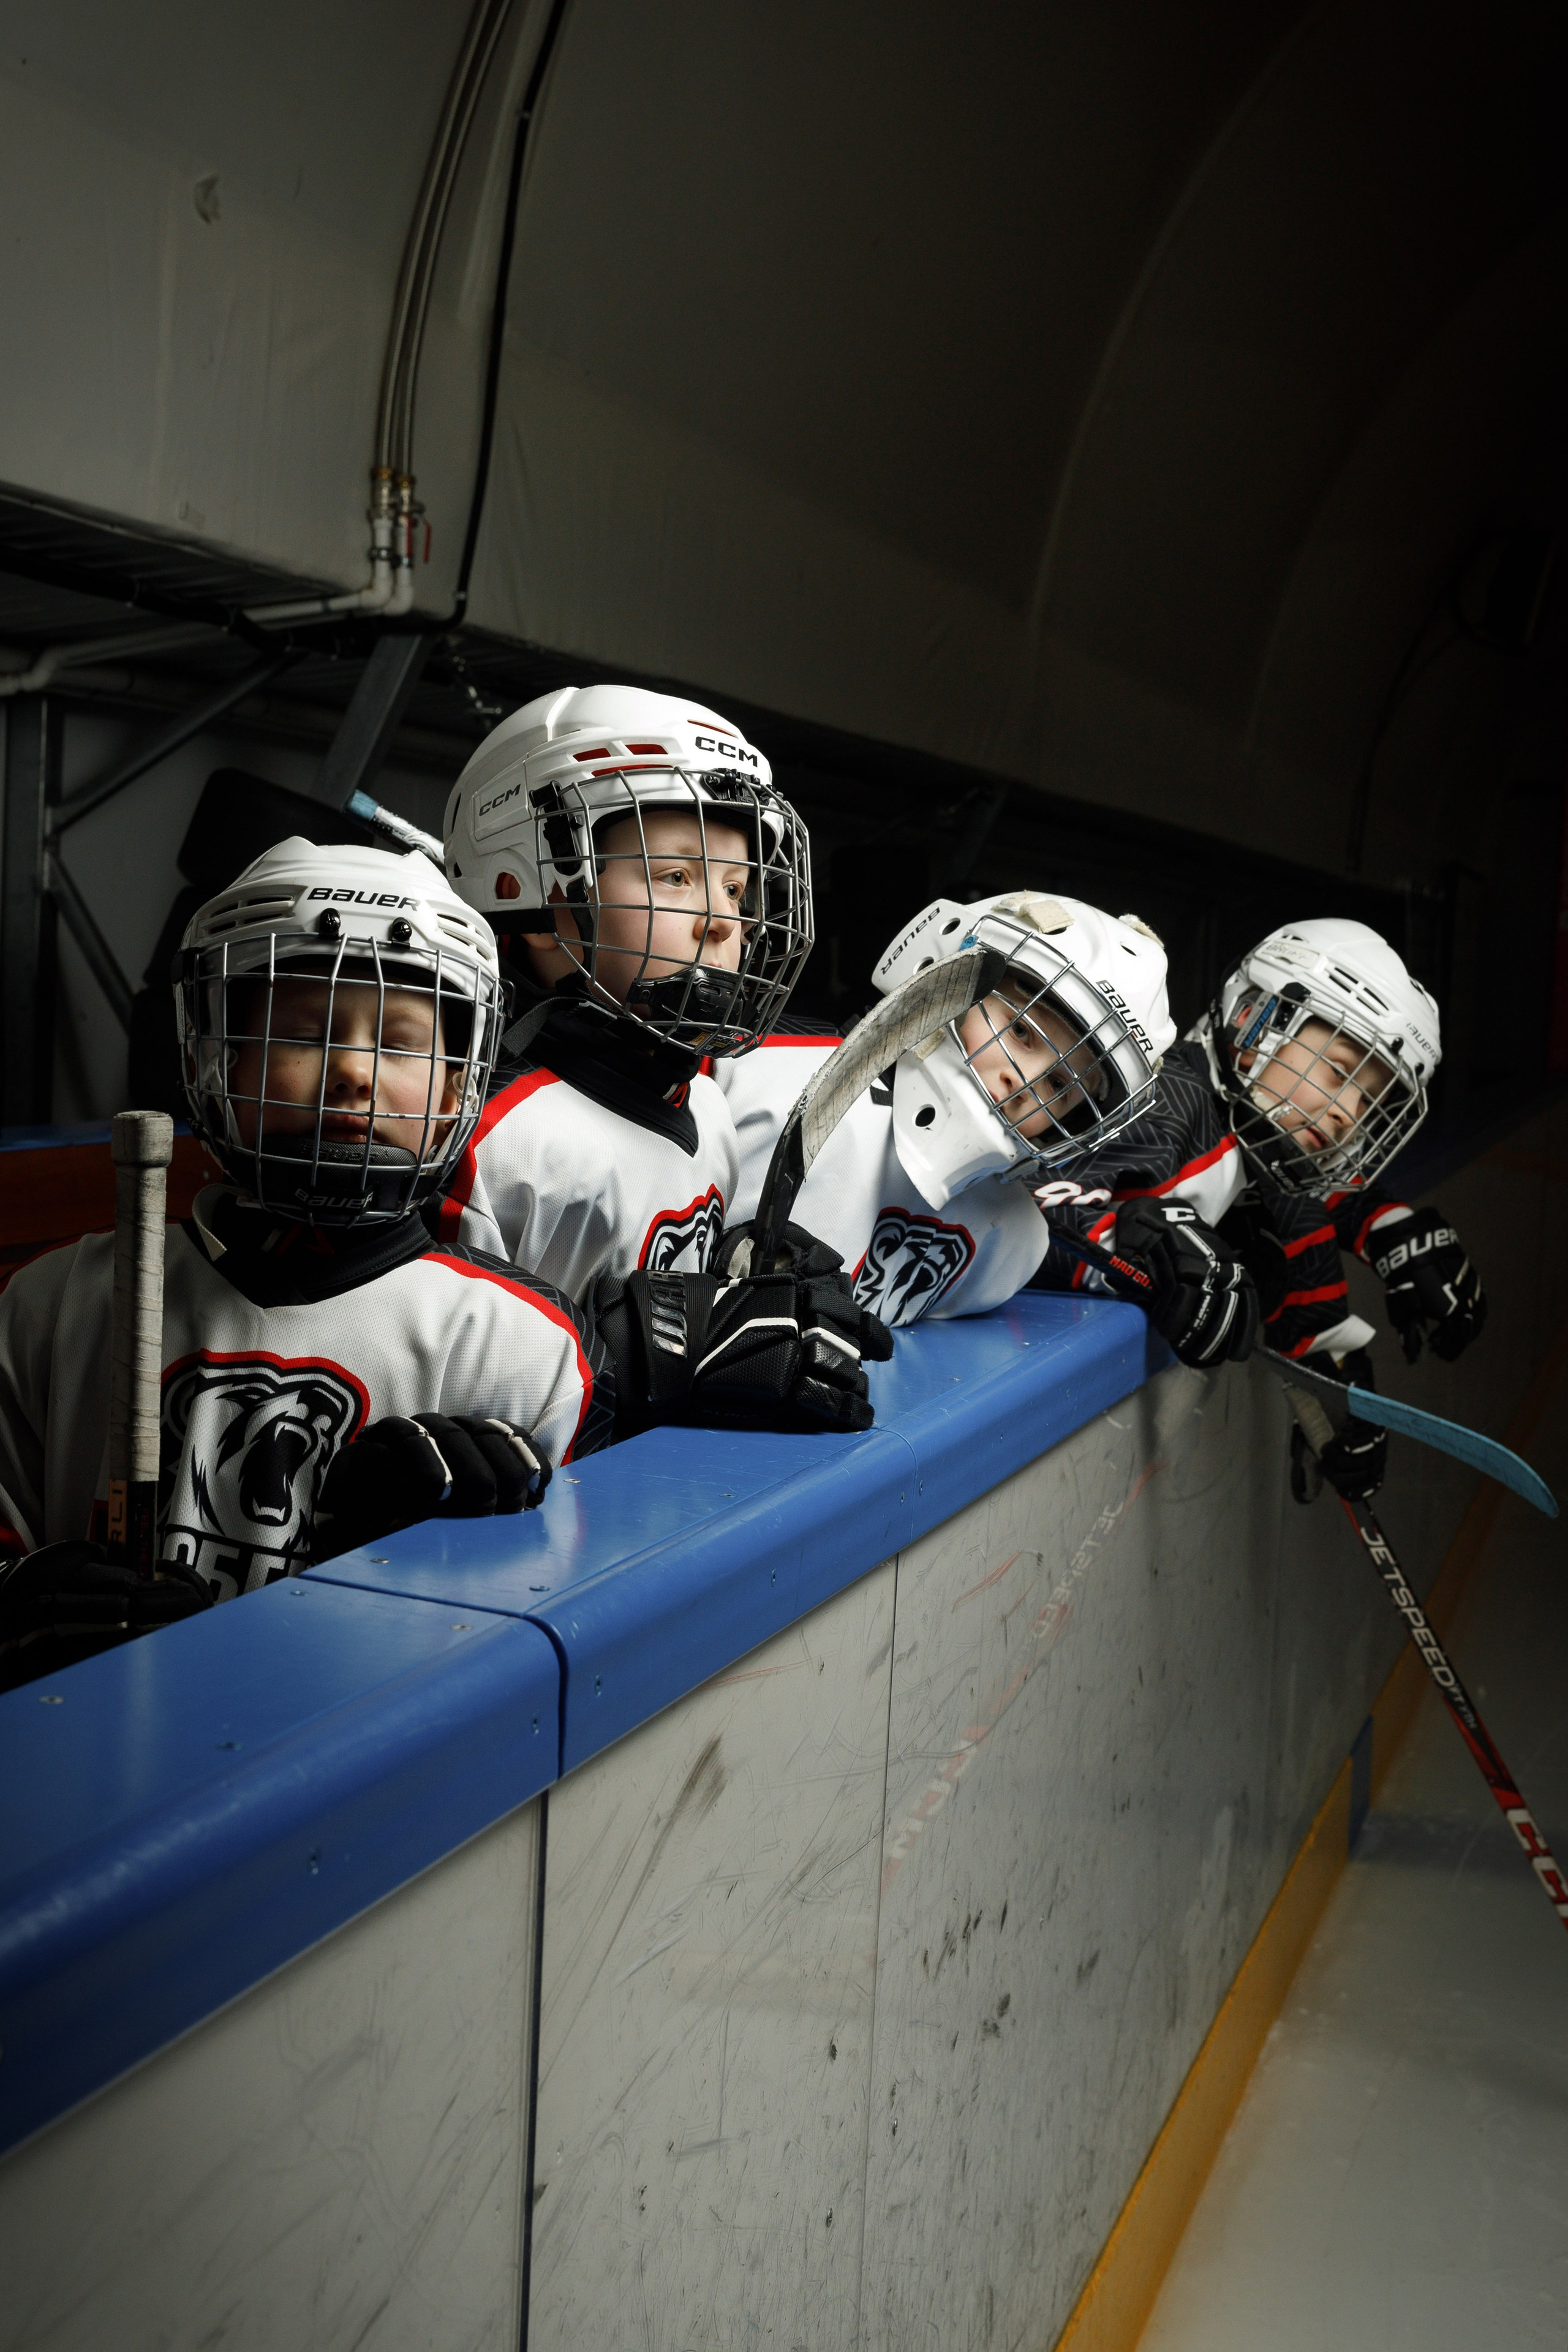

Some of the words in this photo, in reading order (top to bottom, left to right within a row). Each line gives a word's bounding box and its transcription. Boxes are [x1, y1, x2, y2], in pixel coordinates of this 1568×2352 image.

[695, 736, 758, 767] CCM
[478, 783, 521, 817] CCM
[307, 888, 421, 911] BAUER
[880, 907, 941, 976] BAUER
[1095, 979, 1154, 1054] BAUER
[294, 1188, 374, 1210] BAUER
[1375, 1227, 1460, 1280] BAUER
[1109, 1255, 1135, 1276] MAD
[1132, 1270, 1153, 1290] GU
[1360, 1527, 1456, 1687] JETSPEED
